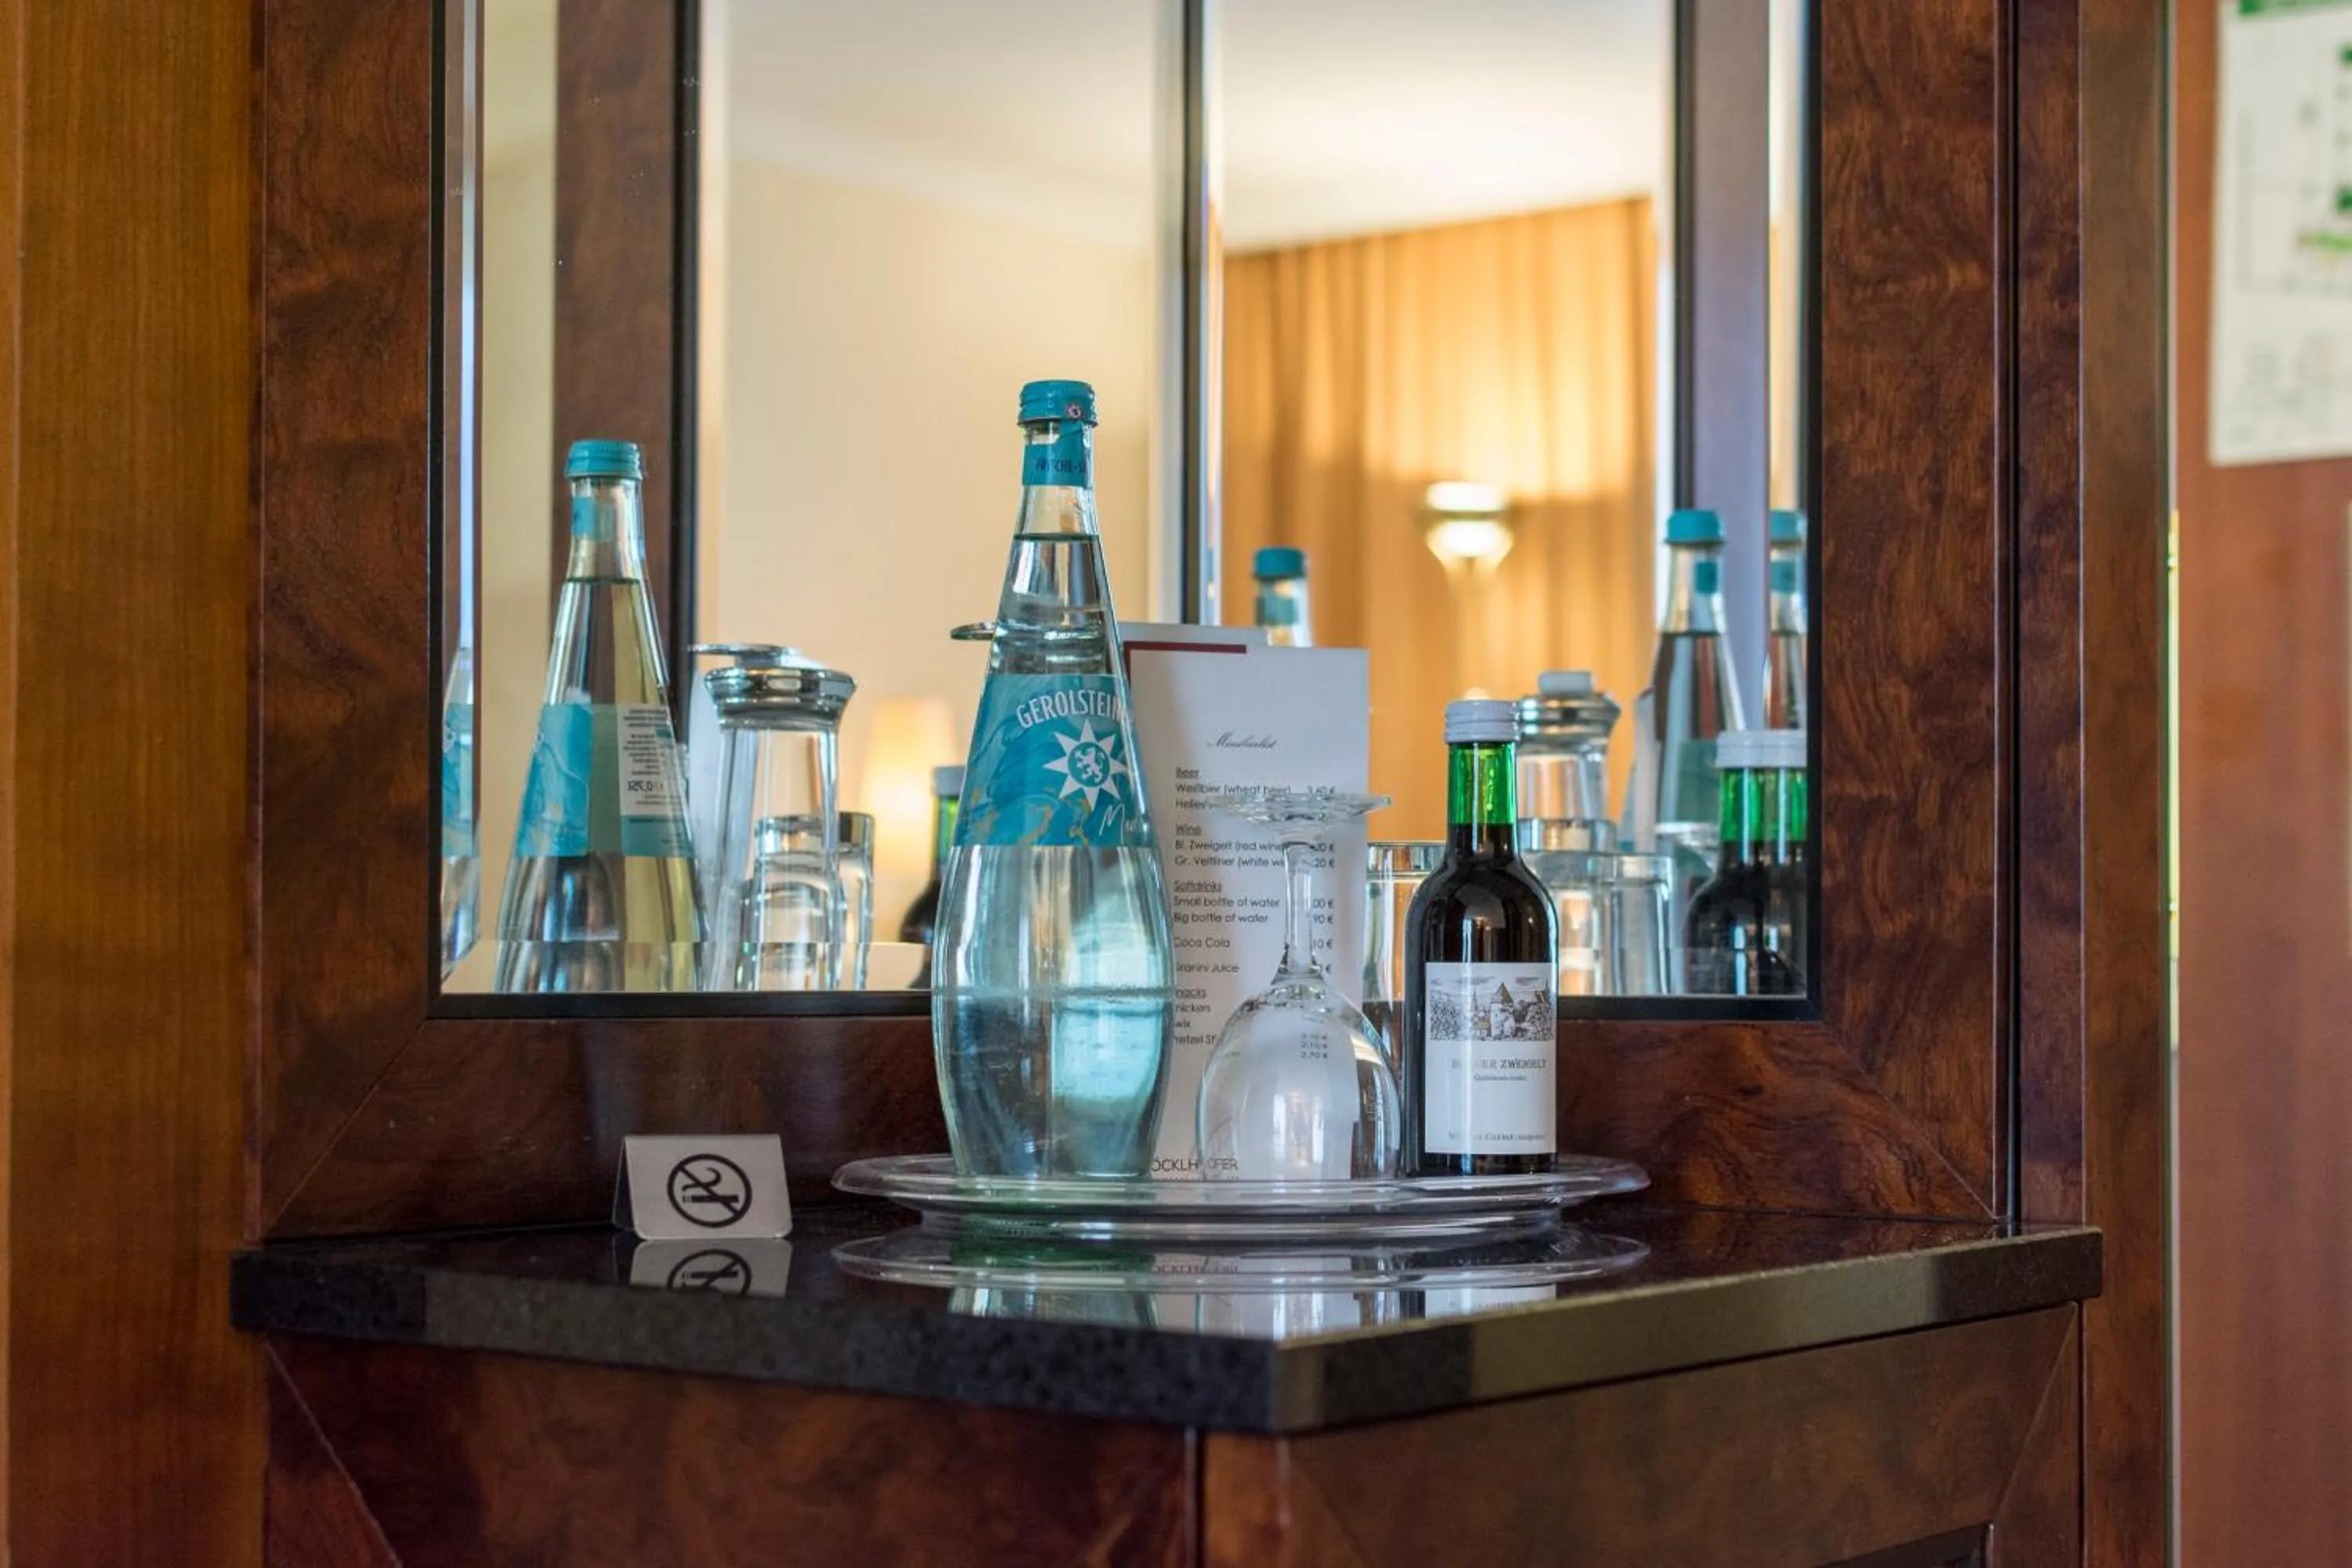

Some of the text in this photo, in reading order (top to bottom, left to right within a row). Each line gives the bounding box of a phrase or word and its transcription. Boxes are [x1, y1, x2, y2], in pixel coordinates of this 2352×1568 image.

[1016, 689, 1121, 729] GEROLSTEIN
[1176, 767, 1200, 779] Beer
[1176, 824, 1202, 836] Wine
[1204, 896, 1234, 906] bottle
[1237, 897, 1248, 906] of
[1250, 897, 1280, 907] water
[1191, 912, 1222, 923] bottle
[1225, 913, 1236, 923] of
[1238, 913, 1269, 923] water
[1206, 938, 1231, 949] Cola
[1212, 964, 1240, 974] Juice
[1175, 988, 1207, 999] nacks
[1175, 1002, 1210, 1013] nickers
[1175, 1018, 1191, 1028] wix
